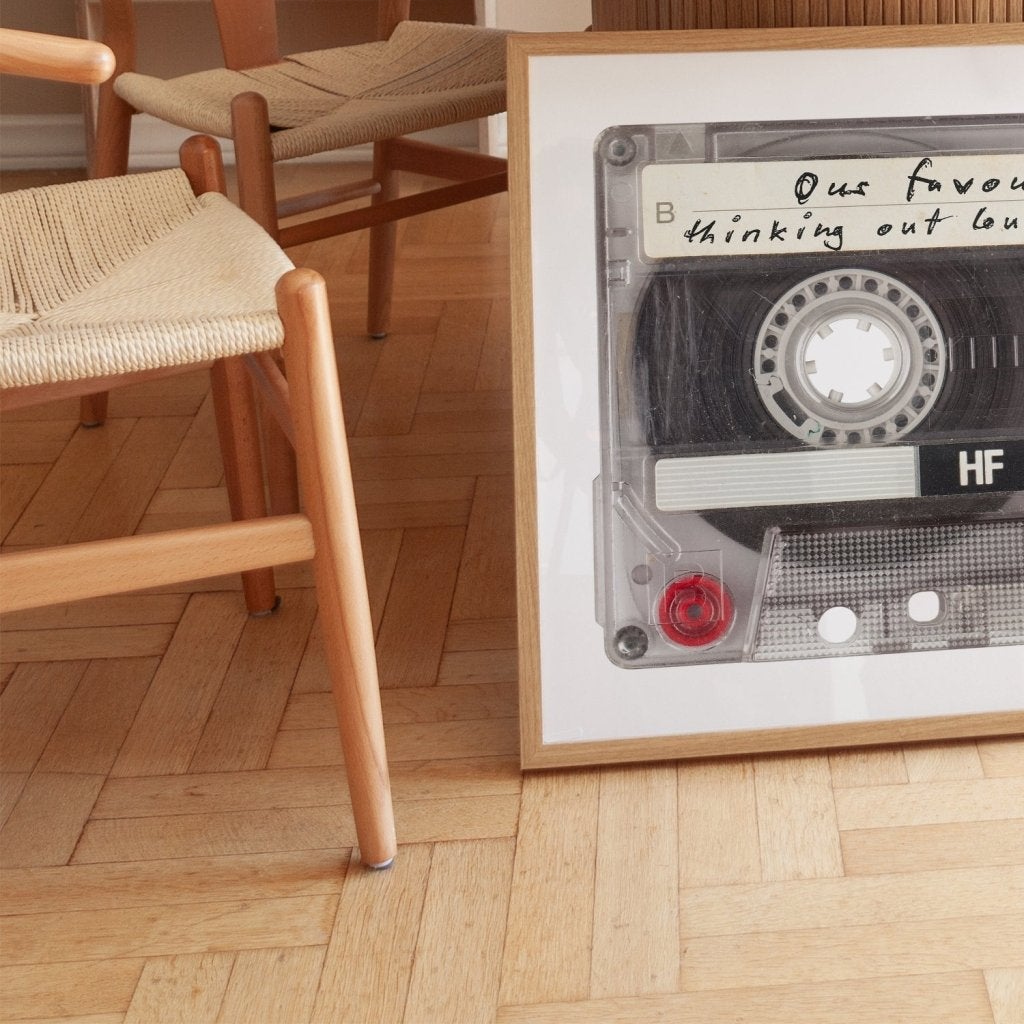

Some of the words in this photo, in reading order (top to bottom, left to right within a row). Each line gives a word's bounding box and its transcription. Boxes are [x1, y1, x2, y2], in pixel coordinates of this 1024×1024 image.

[656, 201, 675, 224] B
[683, 211, 844, 250] thinking
[877, 207, 953, 236] out
[959, 448, 1004, 486] HF
